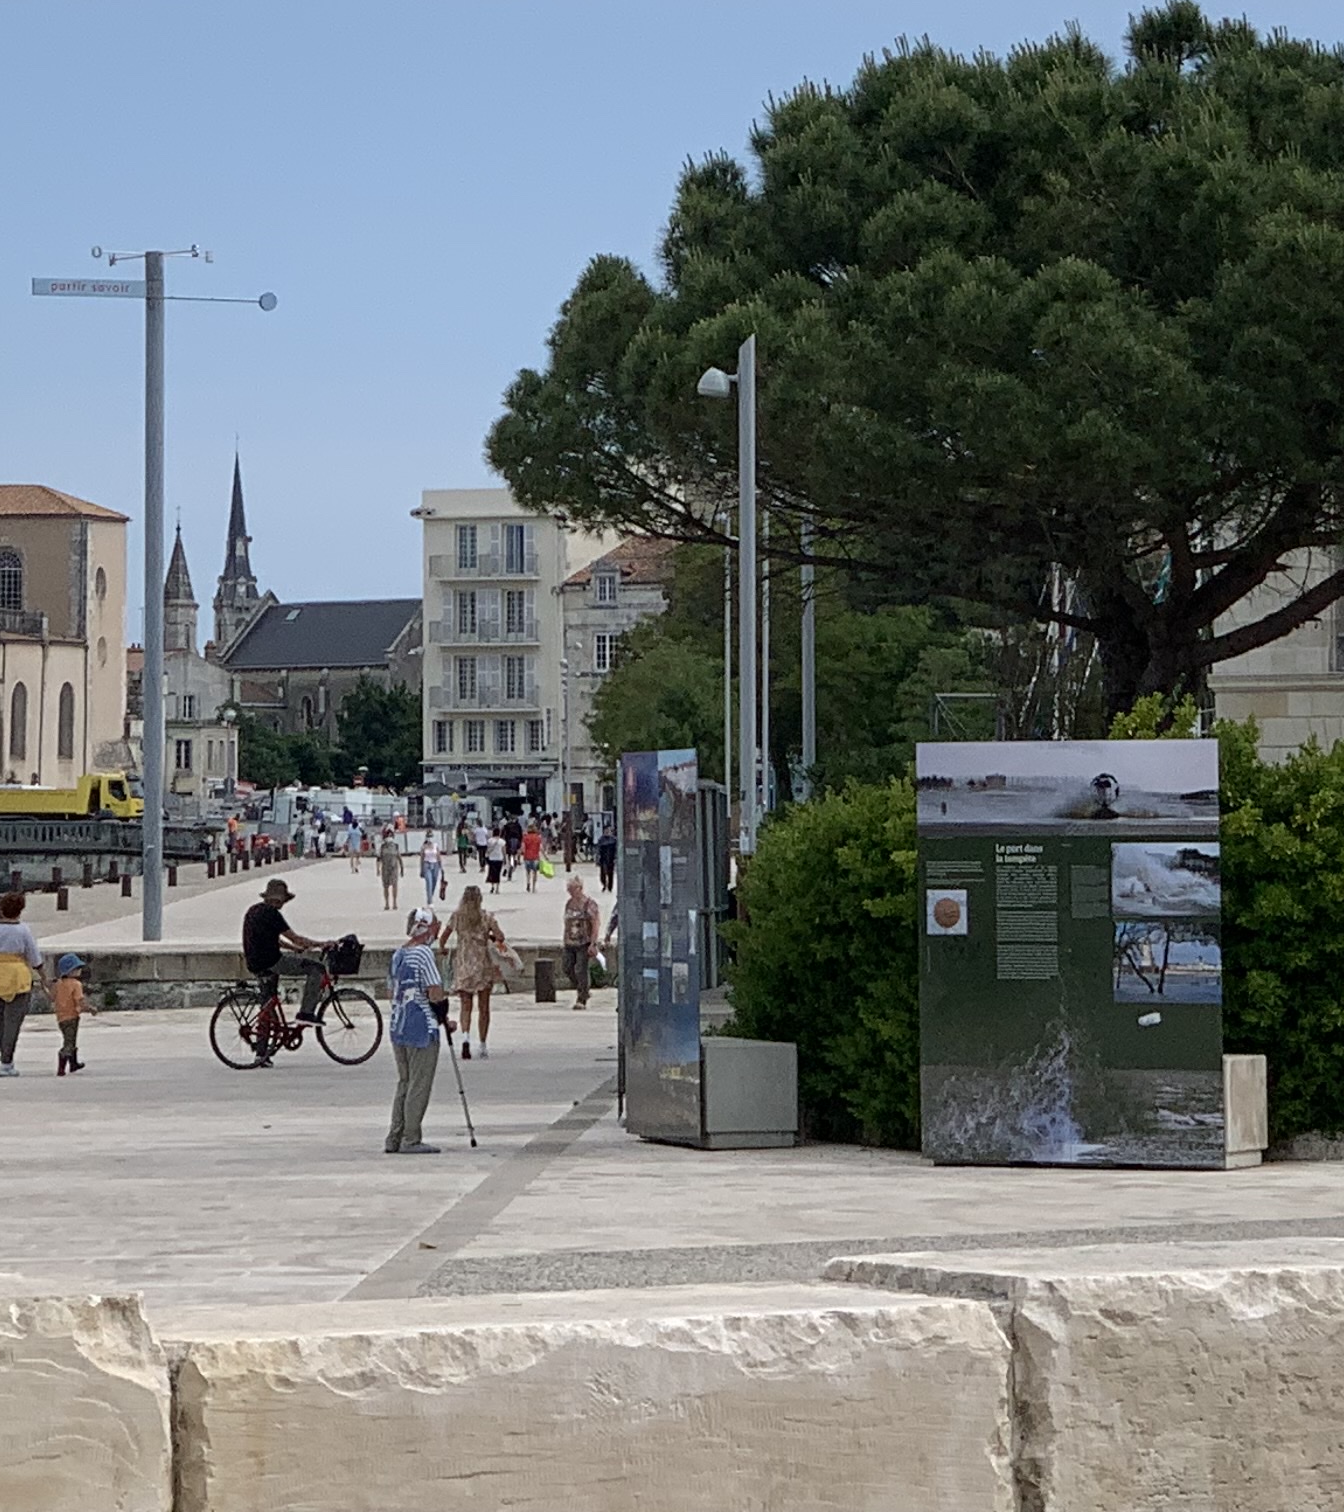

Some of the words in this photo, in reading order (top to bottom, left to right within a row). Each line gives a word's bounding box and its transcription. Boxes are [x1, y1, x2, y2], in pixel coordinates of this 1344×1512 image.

[50, 281, 87, 293] partir
[91, 282, 130, 293] savoir
[995, 843, 1005, 853] Le
[1006, 844, 1023, 854] port
[1024, 843, 1044, 853] dans
